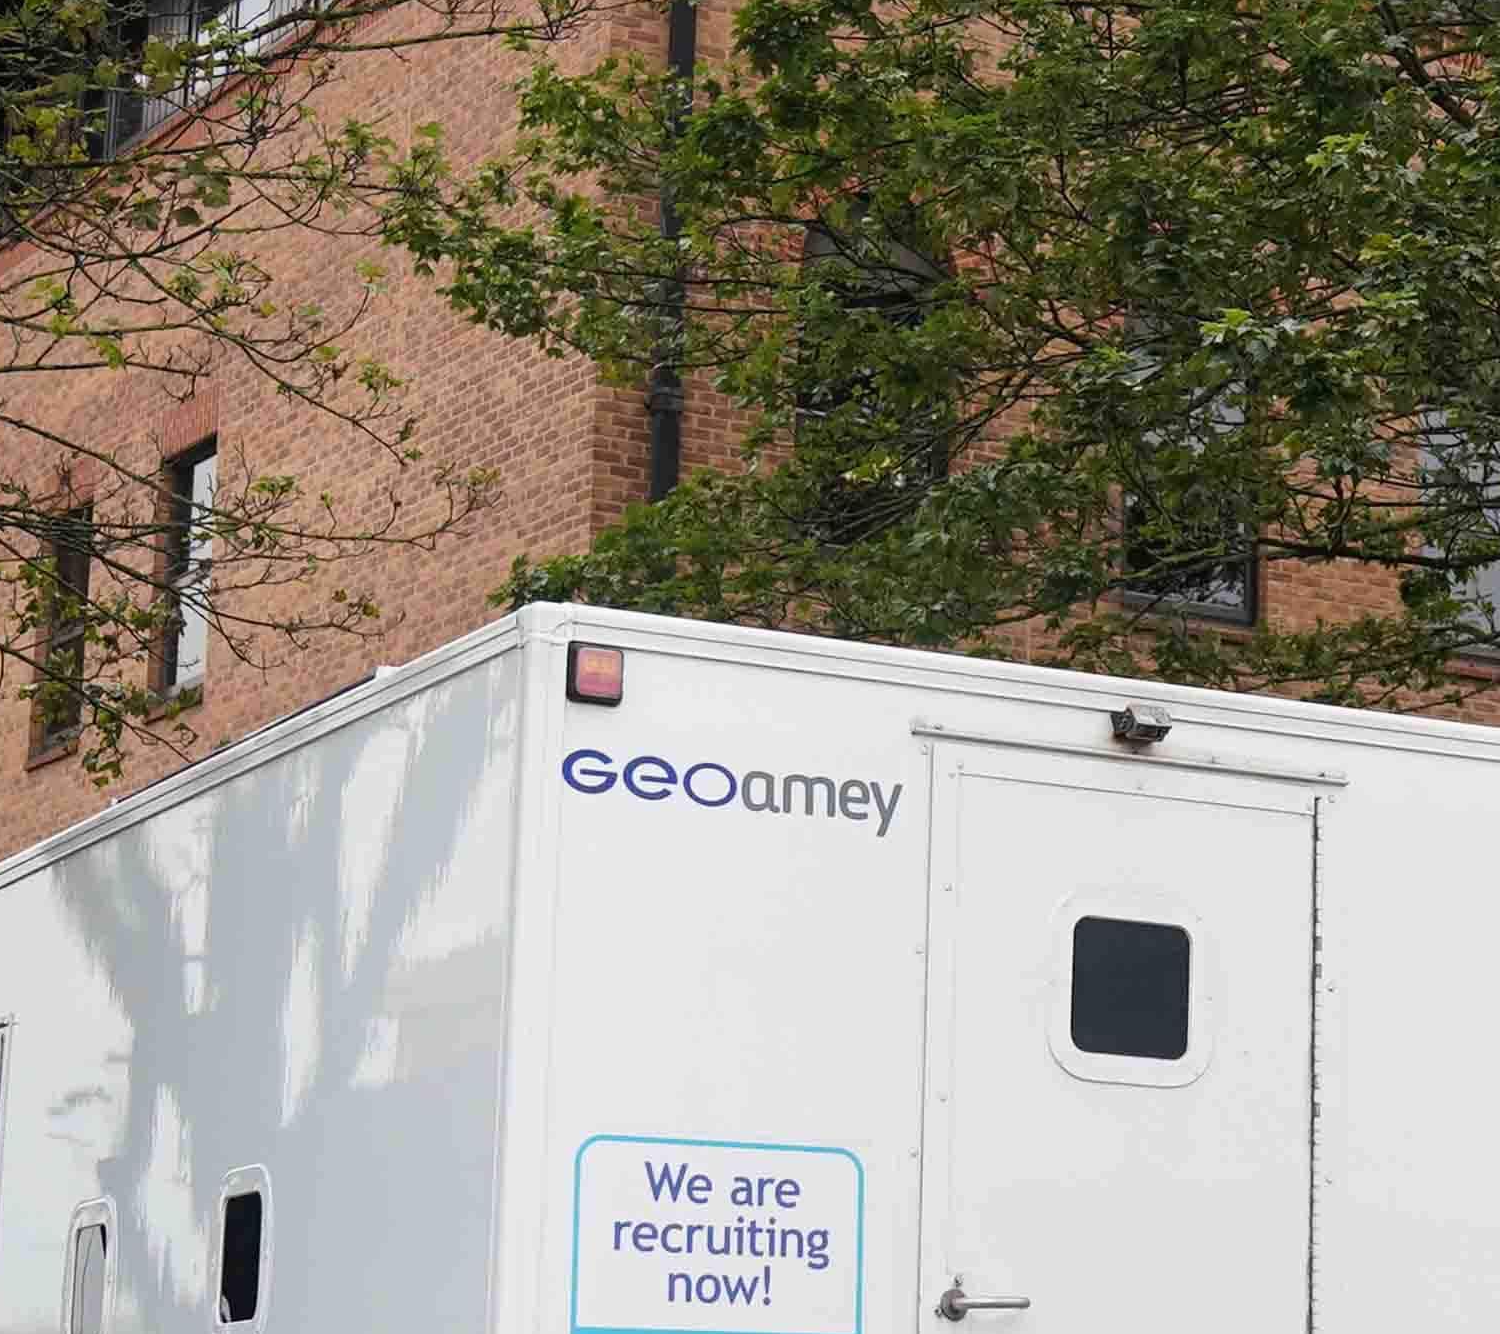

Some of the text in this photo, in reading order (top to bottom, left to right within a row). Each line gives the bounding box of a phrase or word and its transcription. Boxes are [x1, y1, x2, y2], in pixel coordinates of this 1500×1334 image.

[644, 1161, 801, 1209] We are
[613, 1216, 830, 1270] recruiting
[667, 1265, 772, 1307] now!
